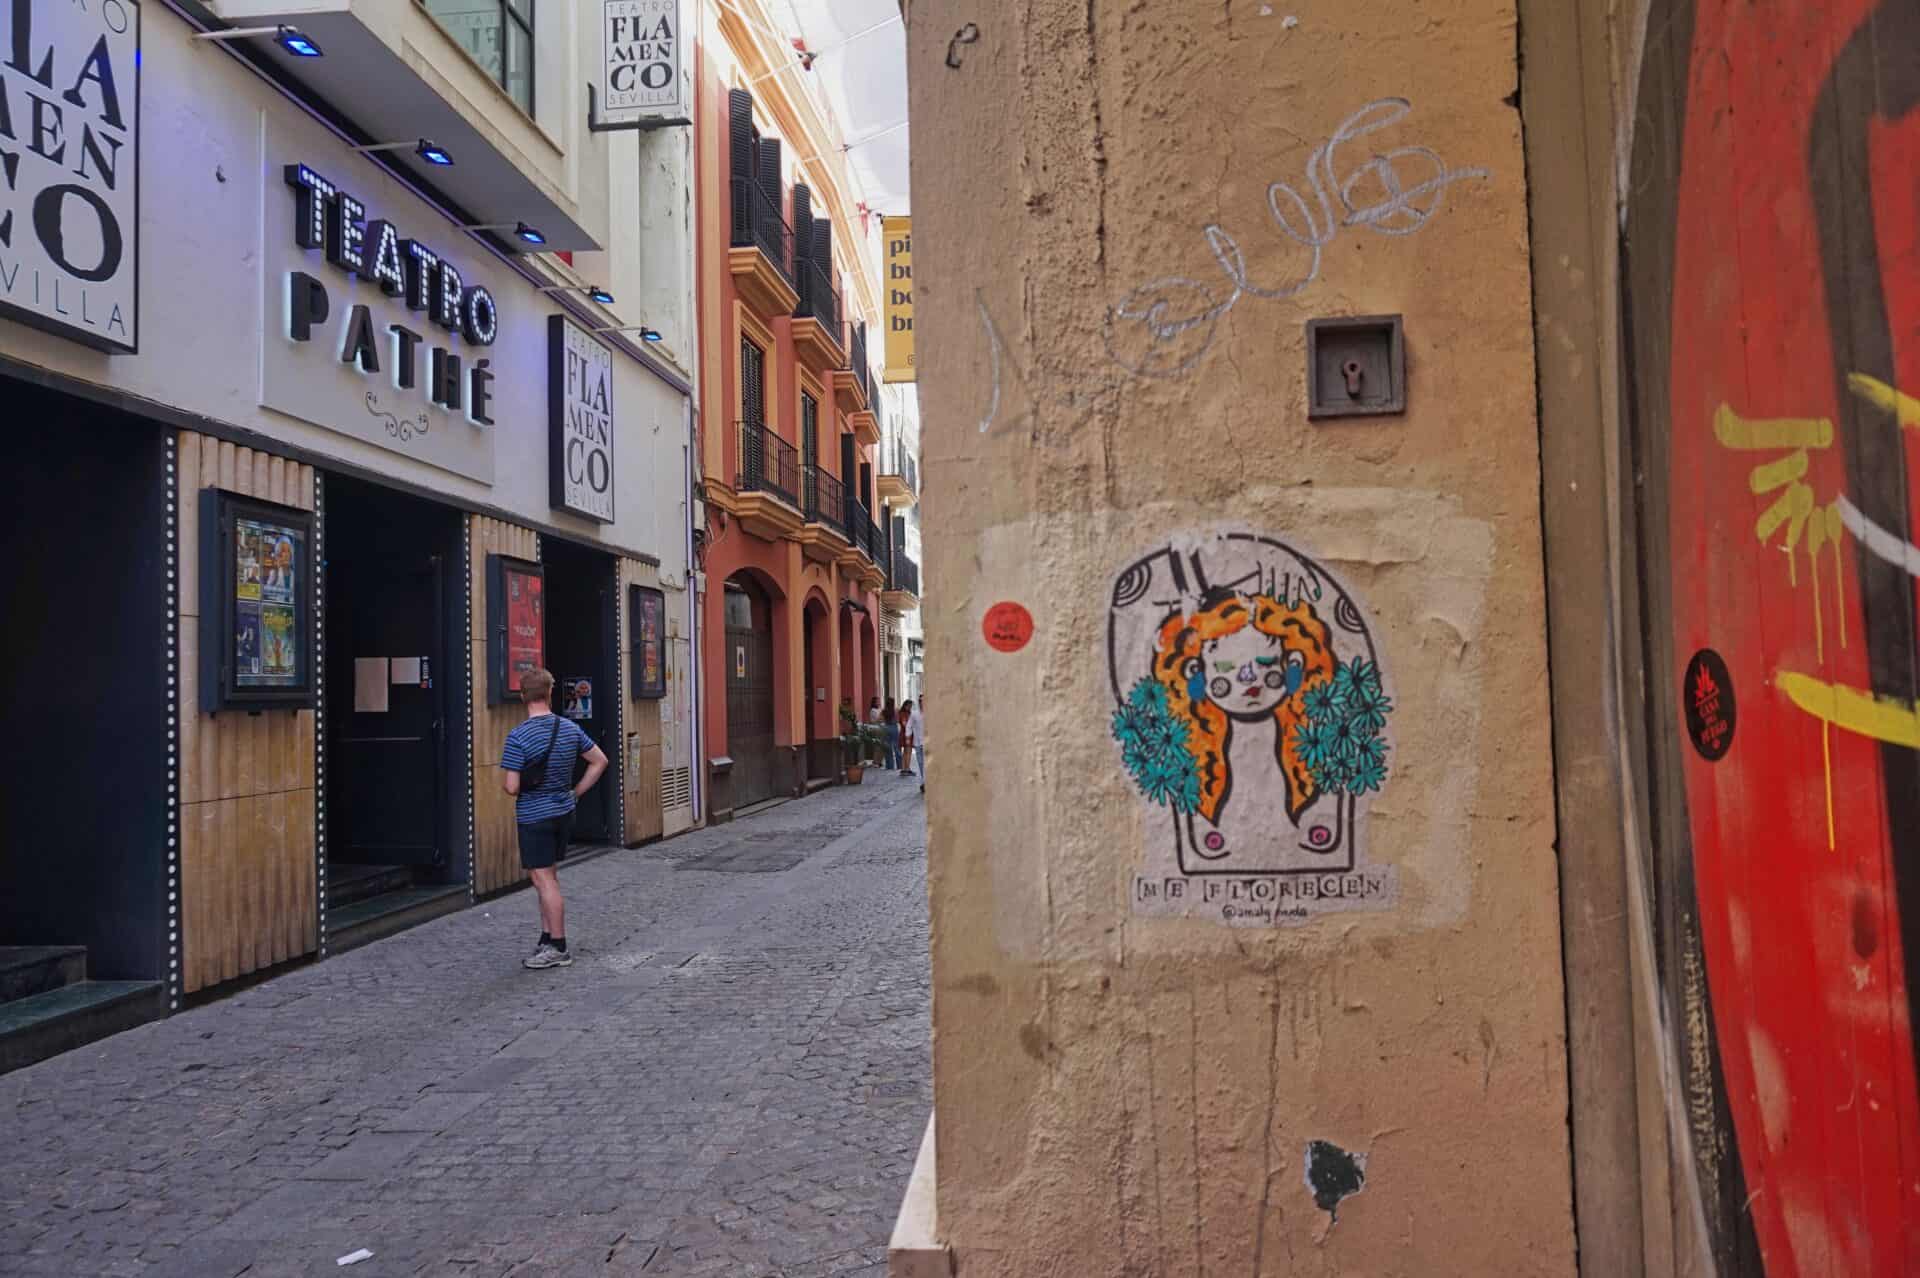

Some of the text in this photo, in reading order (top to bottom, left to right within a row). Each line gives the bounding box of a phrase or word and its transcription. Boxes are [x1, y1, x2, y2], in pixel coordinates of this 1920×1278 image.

[609, 1, 674, 15] TEATRO
[610, 13, 674, 43] FLA
[609, 42, 672, 62] MEN
[611, 62, 673, 92] CO
[609, 91, 674, 105] SEVILLA
[284, 162, 497, 346] TEATRO
[286, 271, 495, 426] PATHÉ
[567, 348, 609, 416] FLA
[566, 404, 609, 447] MEN
[567, 437, 609, 494] CO
[1140, 876, 1382, 900] ME FLORECEN
